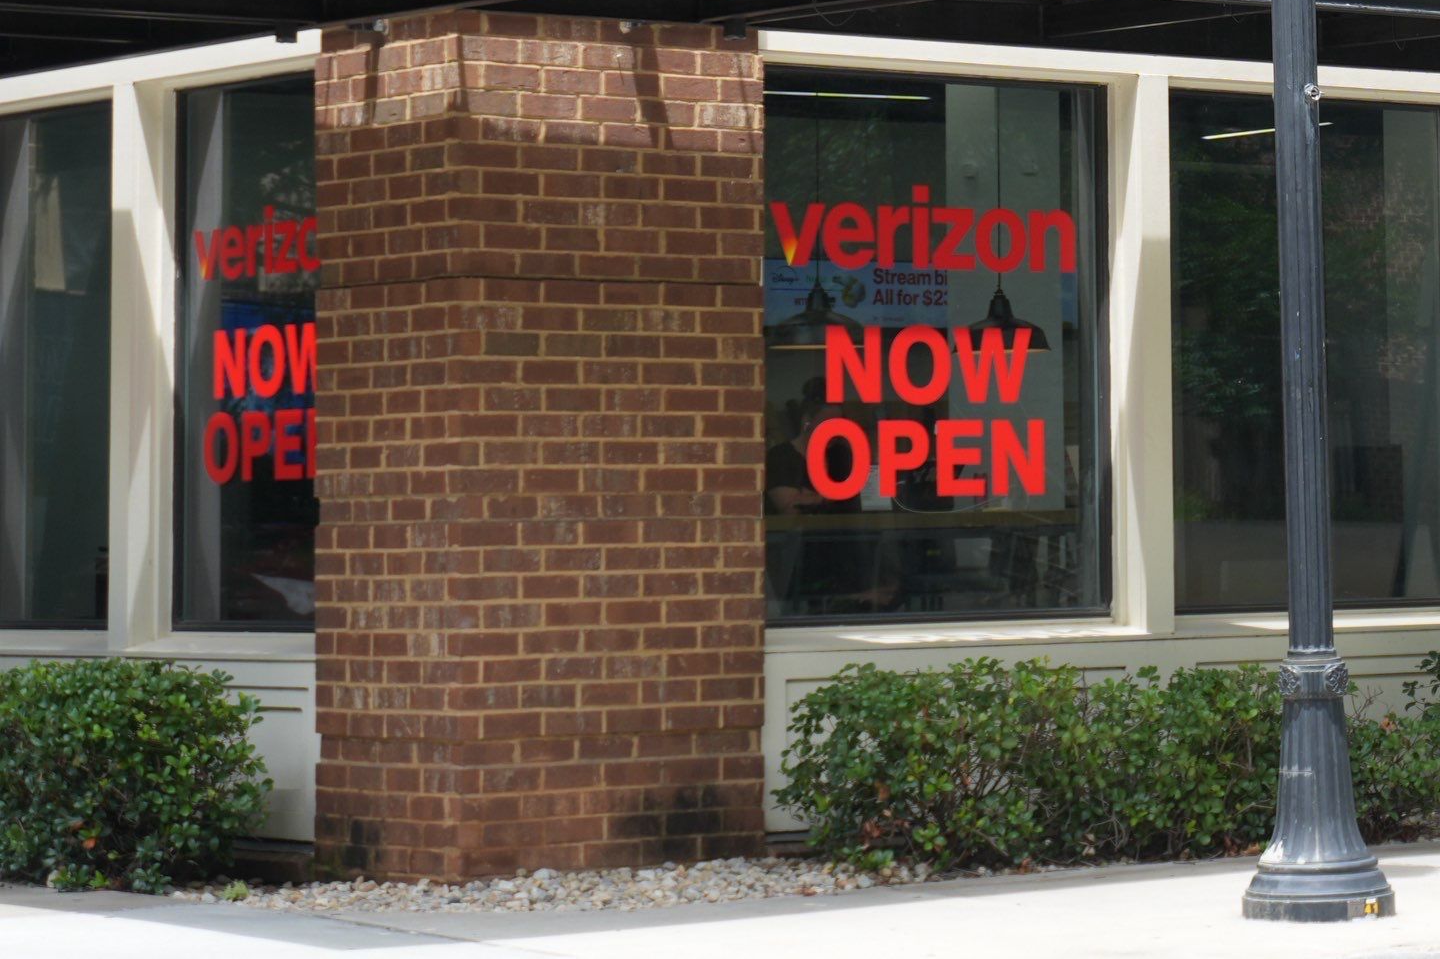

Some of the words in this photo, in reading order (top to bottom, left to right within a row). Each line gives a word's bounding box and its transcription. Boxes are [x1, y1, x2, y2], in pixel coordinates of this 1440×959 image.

[195, 204, 321, 281] verizo
[769, 185, 1077, 273] verizon
[872, 268, 932, 286] Stream
[934, 269, 948, 286] bi
[872, 290, 894, 306] All
[897, 290, 919, 306] for
[212, 322, 318, 401] NOW
[824, 323, 1033, 406] NOW
[806, 417, 1046, 501] OPEN
